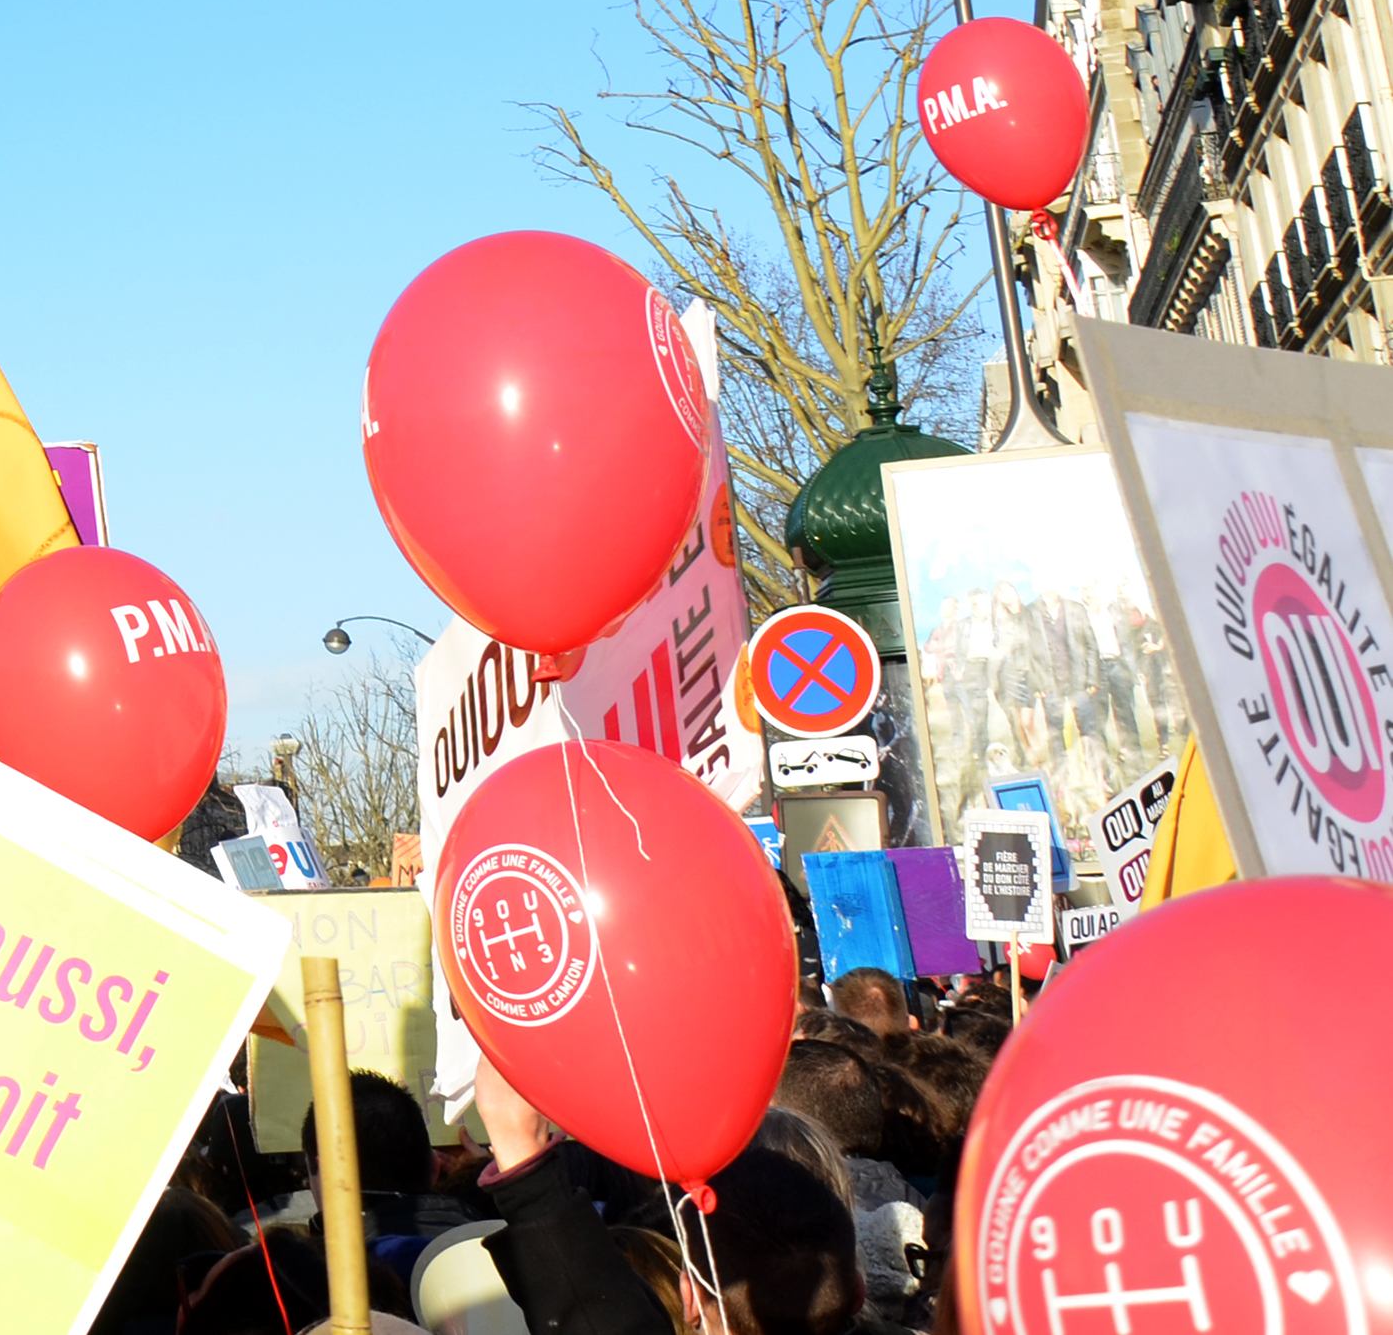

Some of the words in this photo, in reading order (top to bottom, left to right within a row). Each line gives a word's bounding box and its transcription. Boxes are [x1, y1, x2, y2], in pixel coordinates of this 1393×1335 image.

[923, 76, 1008, 135] P.M.A.
[1262, 610, 1381, 774] OUI
[1105, 802, 1140, 848] OUI
[463, 855, 500, 893] COMME
[501, 854, 529, 869] UNE
[528, 859, 577, 909] FAMILLE
[522, 889, 538, 911] U
[1070, 915, 1095, 940] QUI
[1097, 912, 1111, 935] A
[509, 952, 527, 973] N
[536, 943, 554, 964] 3
[485, 991, 528, 1018] COMME
[528, 1000, 549, 1017] UN
[548, 957, 586, 1007] CAMION
[1022, 1099, 1113, 1172] COMME
[1117, 1098, 1190, 1142] UNE
[1185, 1122, 1313, 1259] FAMILLE
[1162, 1197, 1204, 1248] U
